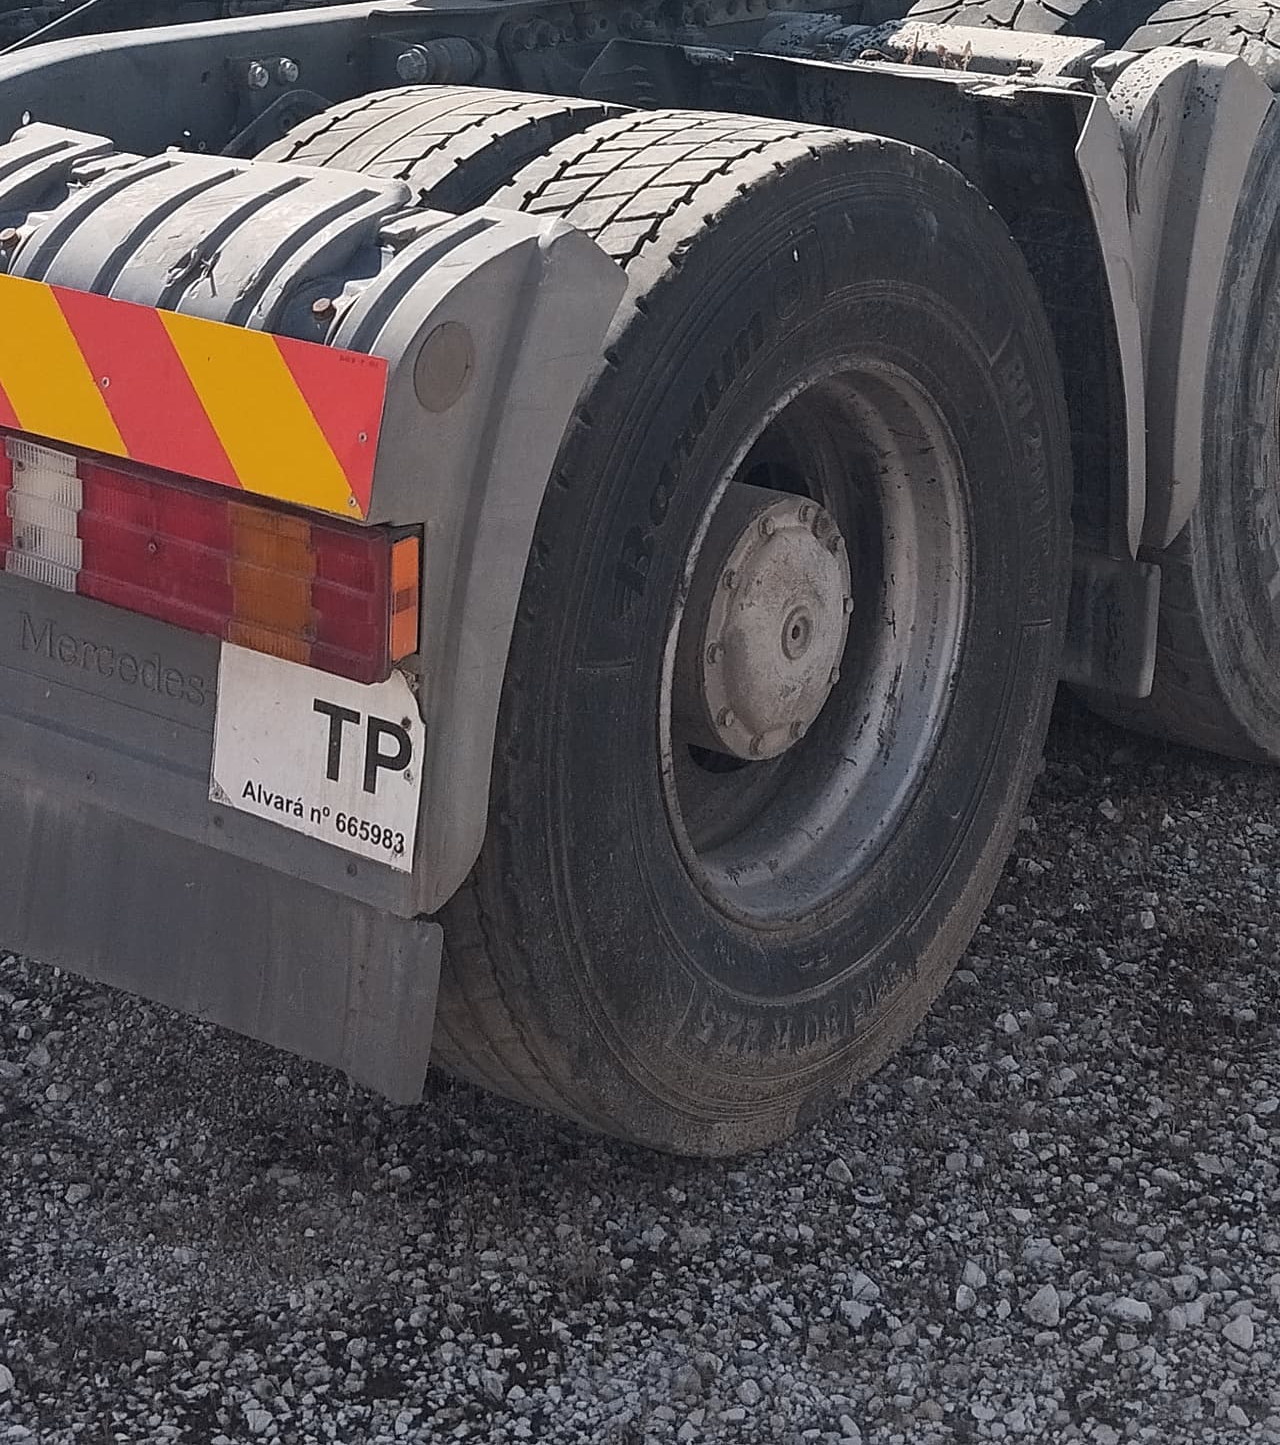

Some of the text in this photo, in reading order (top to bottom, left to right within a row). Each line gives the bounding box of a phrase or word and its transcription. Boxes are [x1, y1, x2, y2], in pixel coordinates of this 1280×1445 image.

[313, 697, 413, 795] TP
[241, 778, 305, 820] Alvará
[335, 811, 406, 854] 665983
